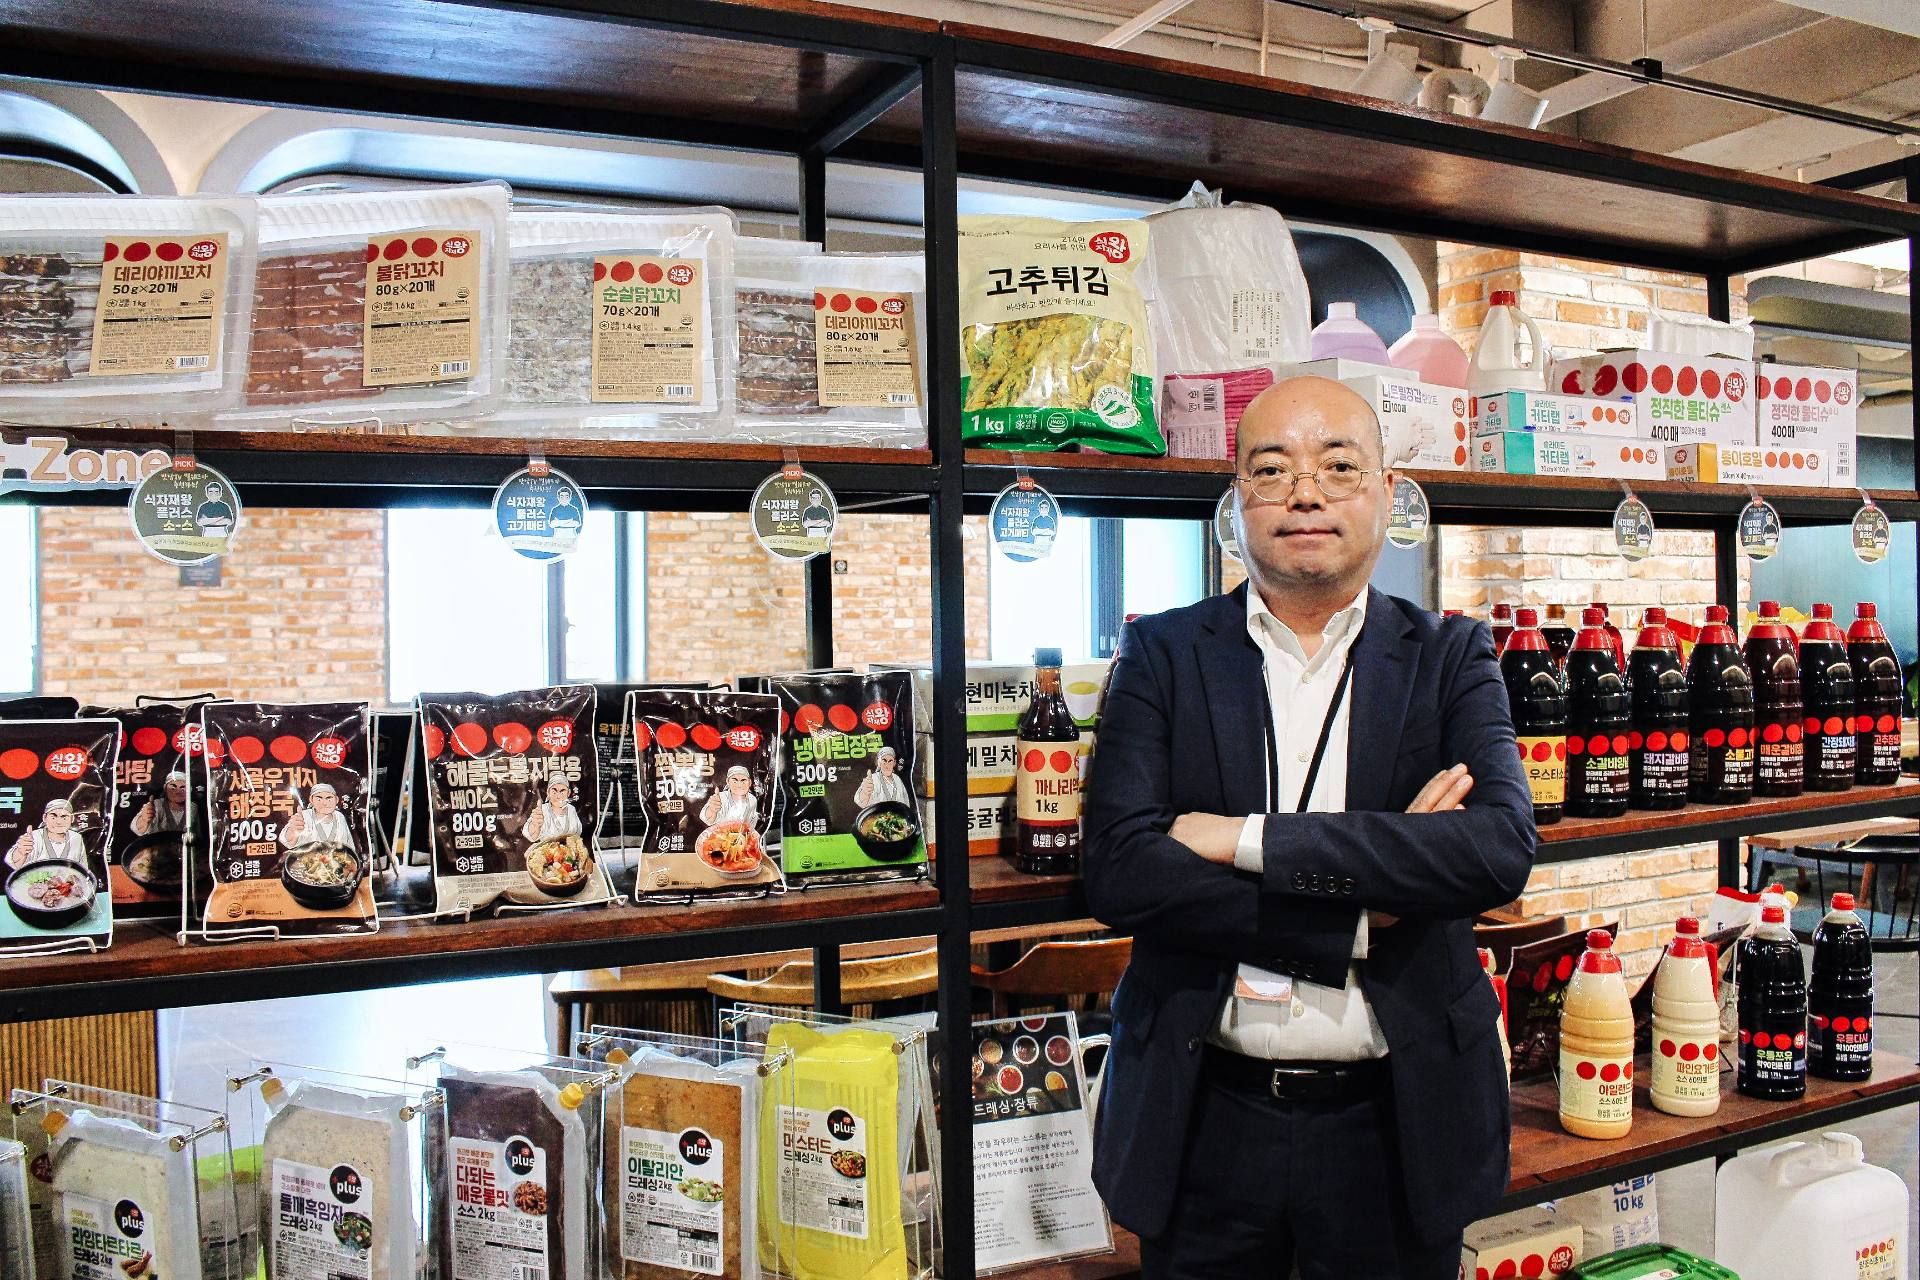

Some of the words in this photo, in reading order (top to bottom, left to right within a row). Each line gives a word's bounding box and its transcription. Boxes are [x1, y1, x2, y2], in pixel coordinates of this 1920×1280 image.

[114, 264, 211, 281] 데리야끼꼬치
[376, 260, 444, 282] 불닭꼬치
[986, 265, 1109, 296] 고추튀김
[603, 286, 680, 304] 순살닭꼬치
[825, 316, 904, 330] 데리야끼꼬치
[1530, 408, 1560, 425] 커터랩
[1650, 397, 1684, 420] 정직한
[1687, 399, 1720, 422] 물티슈
[1771, 404, 1800, 422] 정직한
[1801, 405, 1829, 422] 물티슈
[1651, 425, 1679, 443] 400매
[1771, 425, 1795, 438] 400매
[30, 440, 169, 481] Zone
[1540, 449, 1570, 465] 커터랩
[1721, 451, 1762, 468] 종이호일
[144, 493, 192, 506] 식자재왕
[506, 497, 546, 508] 식자재왕
[762, 500, 799, 511] 식자재왕
[157, 507, 193, 519] 플러스
[516, 509, 546, 520] 플러스
[771, 510, 800, 521] 플러스
[1001, 507, 1030, 517] 식자재왕
[966, 680, 1034, 705] 현미녹차
[793, 733, 884, 762] 냉이된장국
[446, 756, 581, 786] 해물누룽지탕용
[654, 753, 715, 777] 짬뽕탕
[1586, 756, 1629, 770] 소갈비양
[228, 791, 294, 819] 해장국
[450, 787, 498, 810] 베이스
[1036, 800, 1058, 814] 1kg
[833, 1121, 857, 1134] plus
[687, 1144, 713, 1158] plus
[783, 1133, 833, 1154] 머스터드
[512, 1154, 535, 1167] plus
[784, 1150, 810, 1164] 드레싱
[457, 1165, 495, 1187] 다되는
[628, 1157, 683, 1182] 이탈리안
[337, 1181, 362, 1196] plus
[628, 1175, 658, 1192] 드레싱
[457, 1184, 509, 1208] 매운불맛
[280, 1192, 344, 1224] 들깨흑임자
[457, 1204, 476, 1219] 소스
[122, 1215, 144, 1231] plus
[280, 1213, 308, 1232] 드레싱
